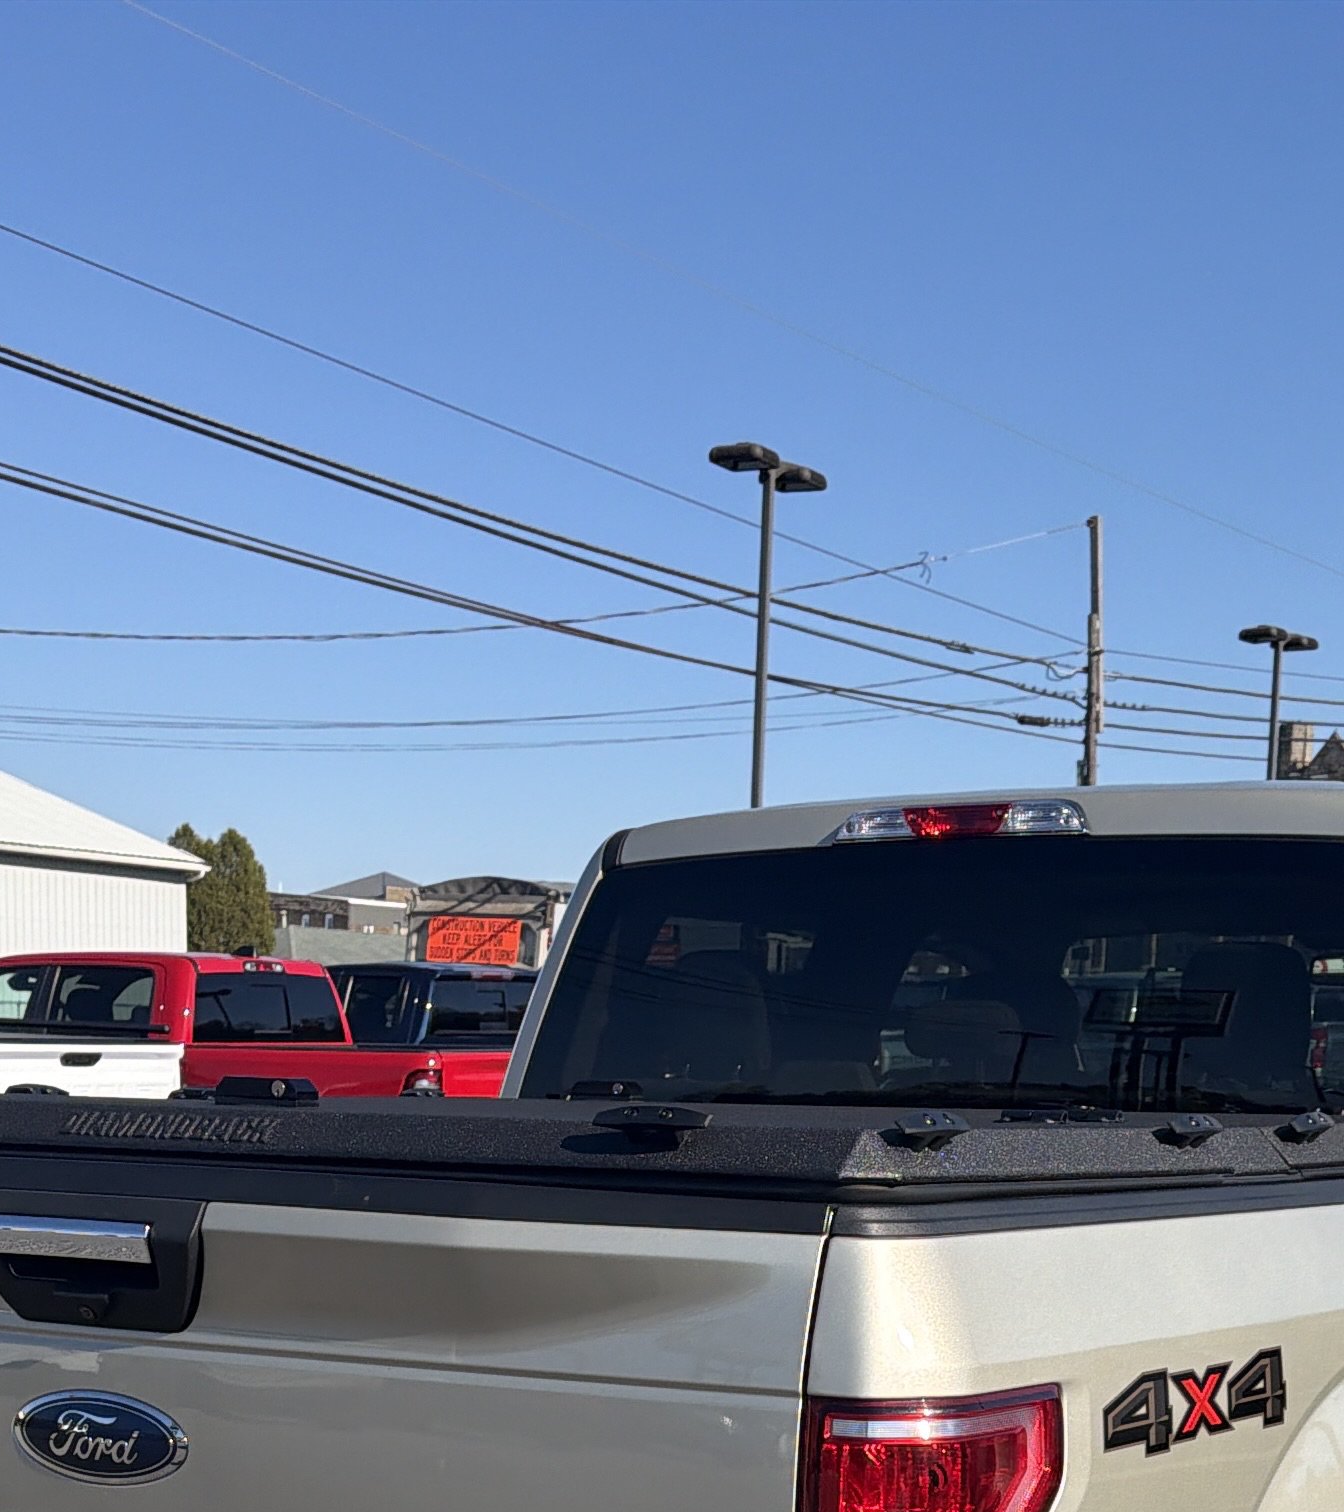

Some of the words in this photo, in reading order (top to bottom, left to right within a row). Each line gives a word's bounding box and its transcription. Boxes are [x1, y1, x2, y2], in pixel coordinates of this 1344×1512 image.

[431, 918, 485, 932] CONSTRUCTION
[442, 933, 461, 945] KEEP
[429, 946, 453, 959] SUDDEN
[480, 949, 492, 961] AND
[49, 1409, 142, 1465] Ford
